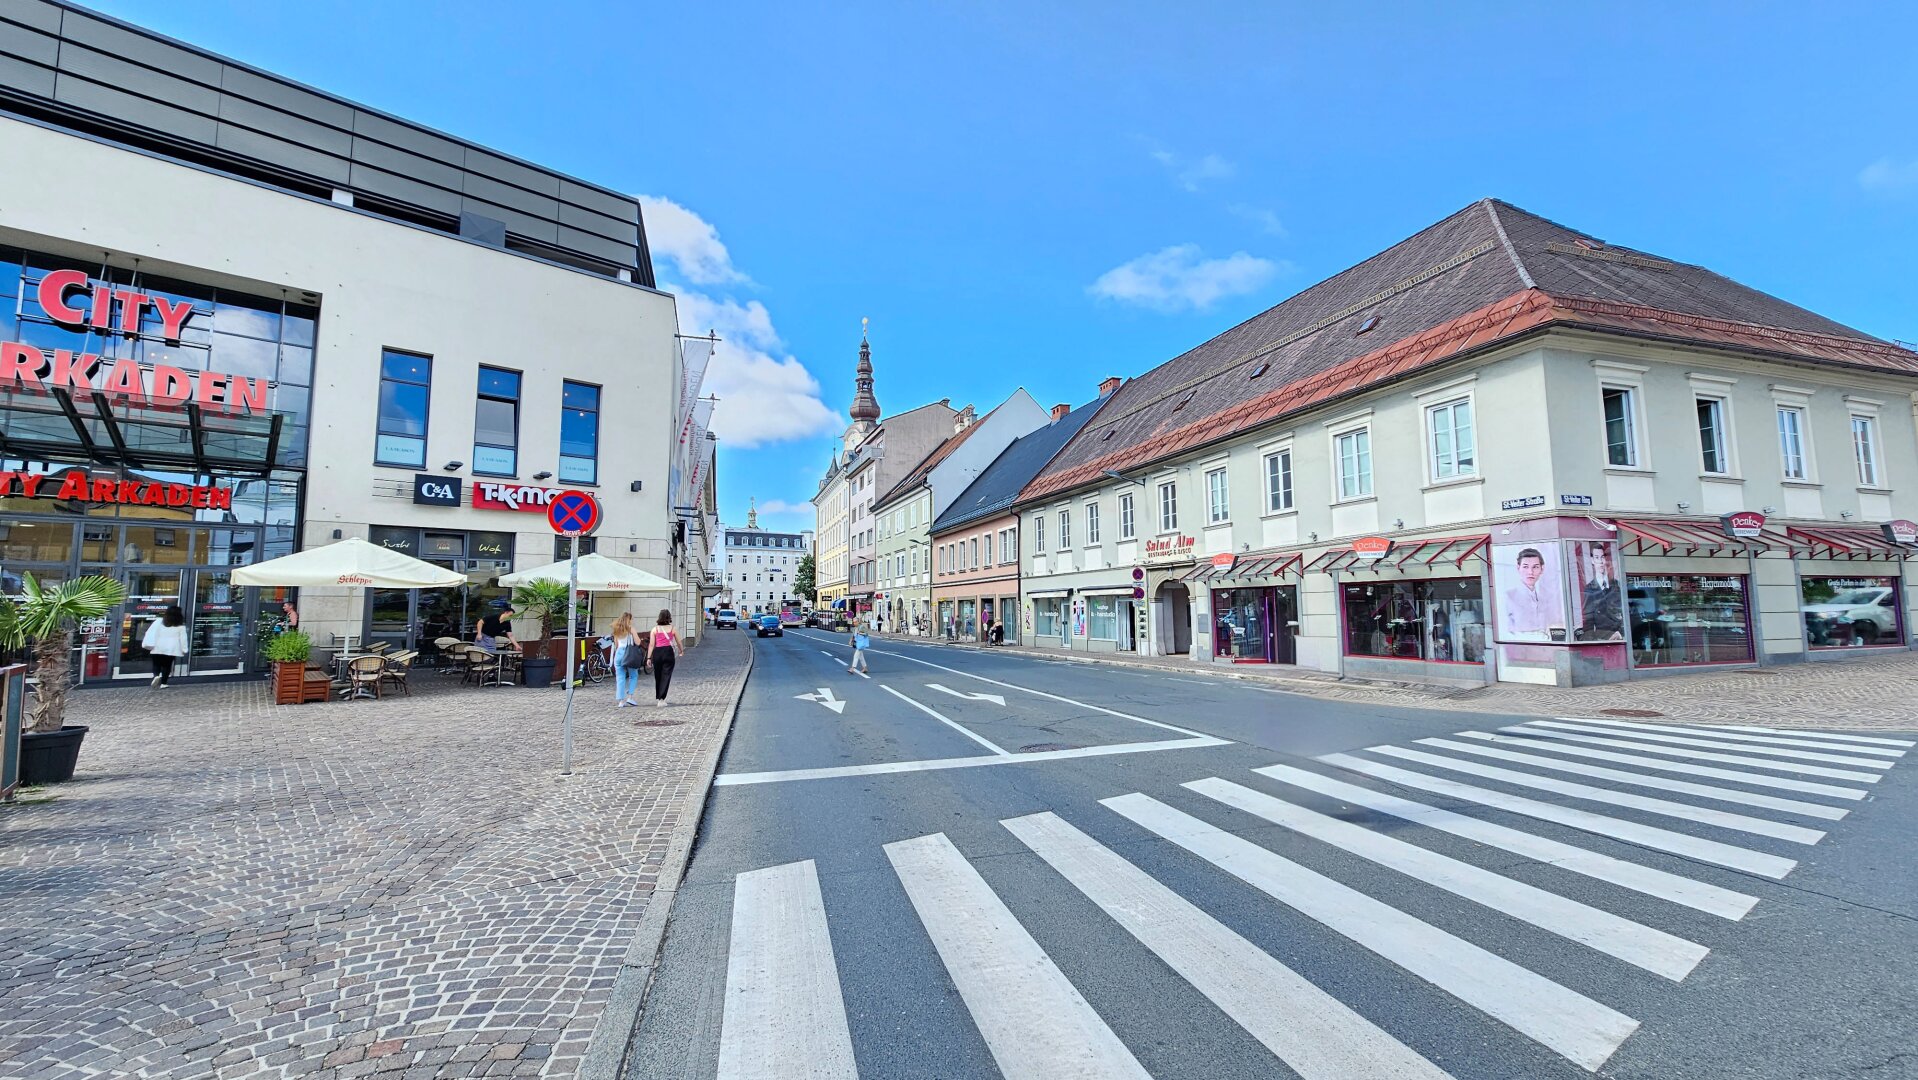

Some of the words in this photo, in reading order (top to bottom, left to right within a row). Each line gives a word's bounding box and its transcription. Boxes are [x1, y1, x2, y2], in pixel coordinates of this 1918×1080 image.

[38, 269, 194, 340] CITY
[57, 470, 233, 509] ARKADEN
[421, 482, 455, 500] C&A
[1732, 516, 1762, 528] Penker
[383, 538, 411, 549] Sushi
[478, 544, 502, 554] Wok
[1145, 538, 1171, 552] Salud
[1174, 535, 1195, 549] Alm
